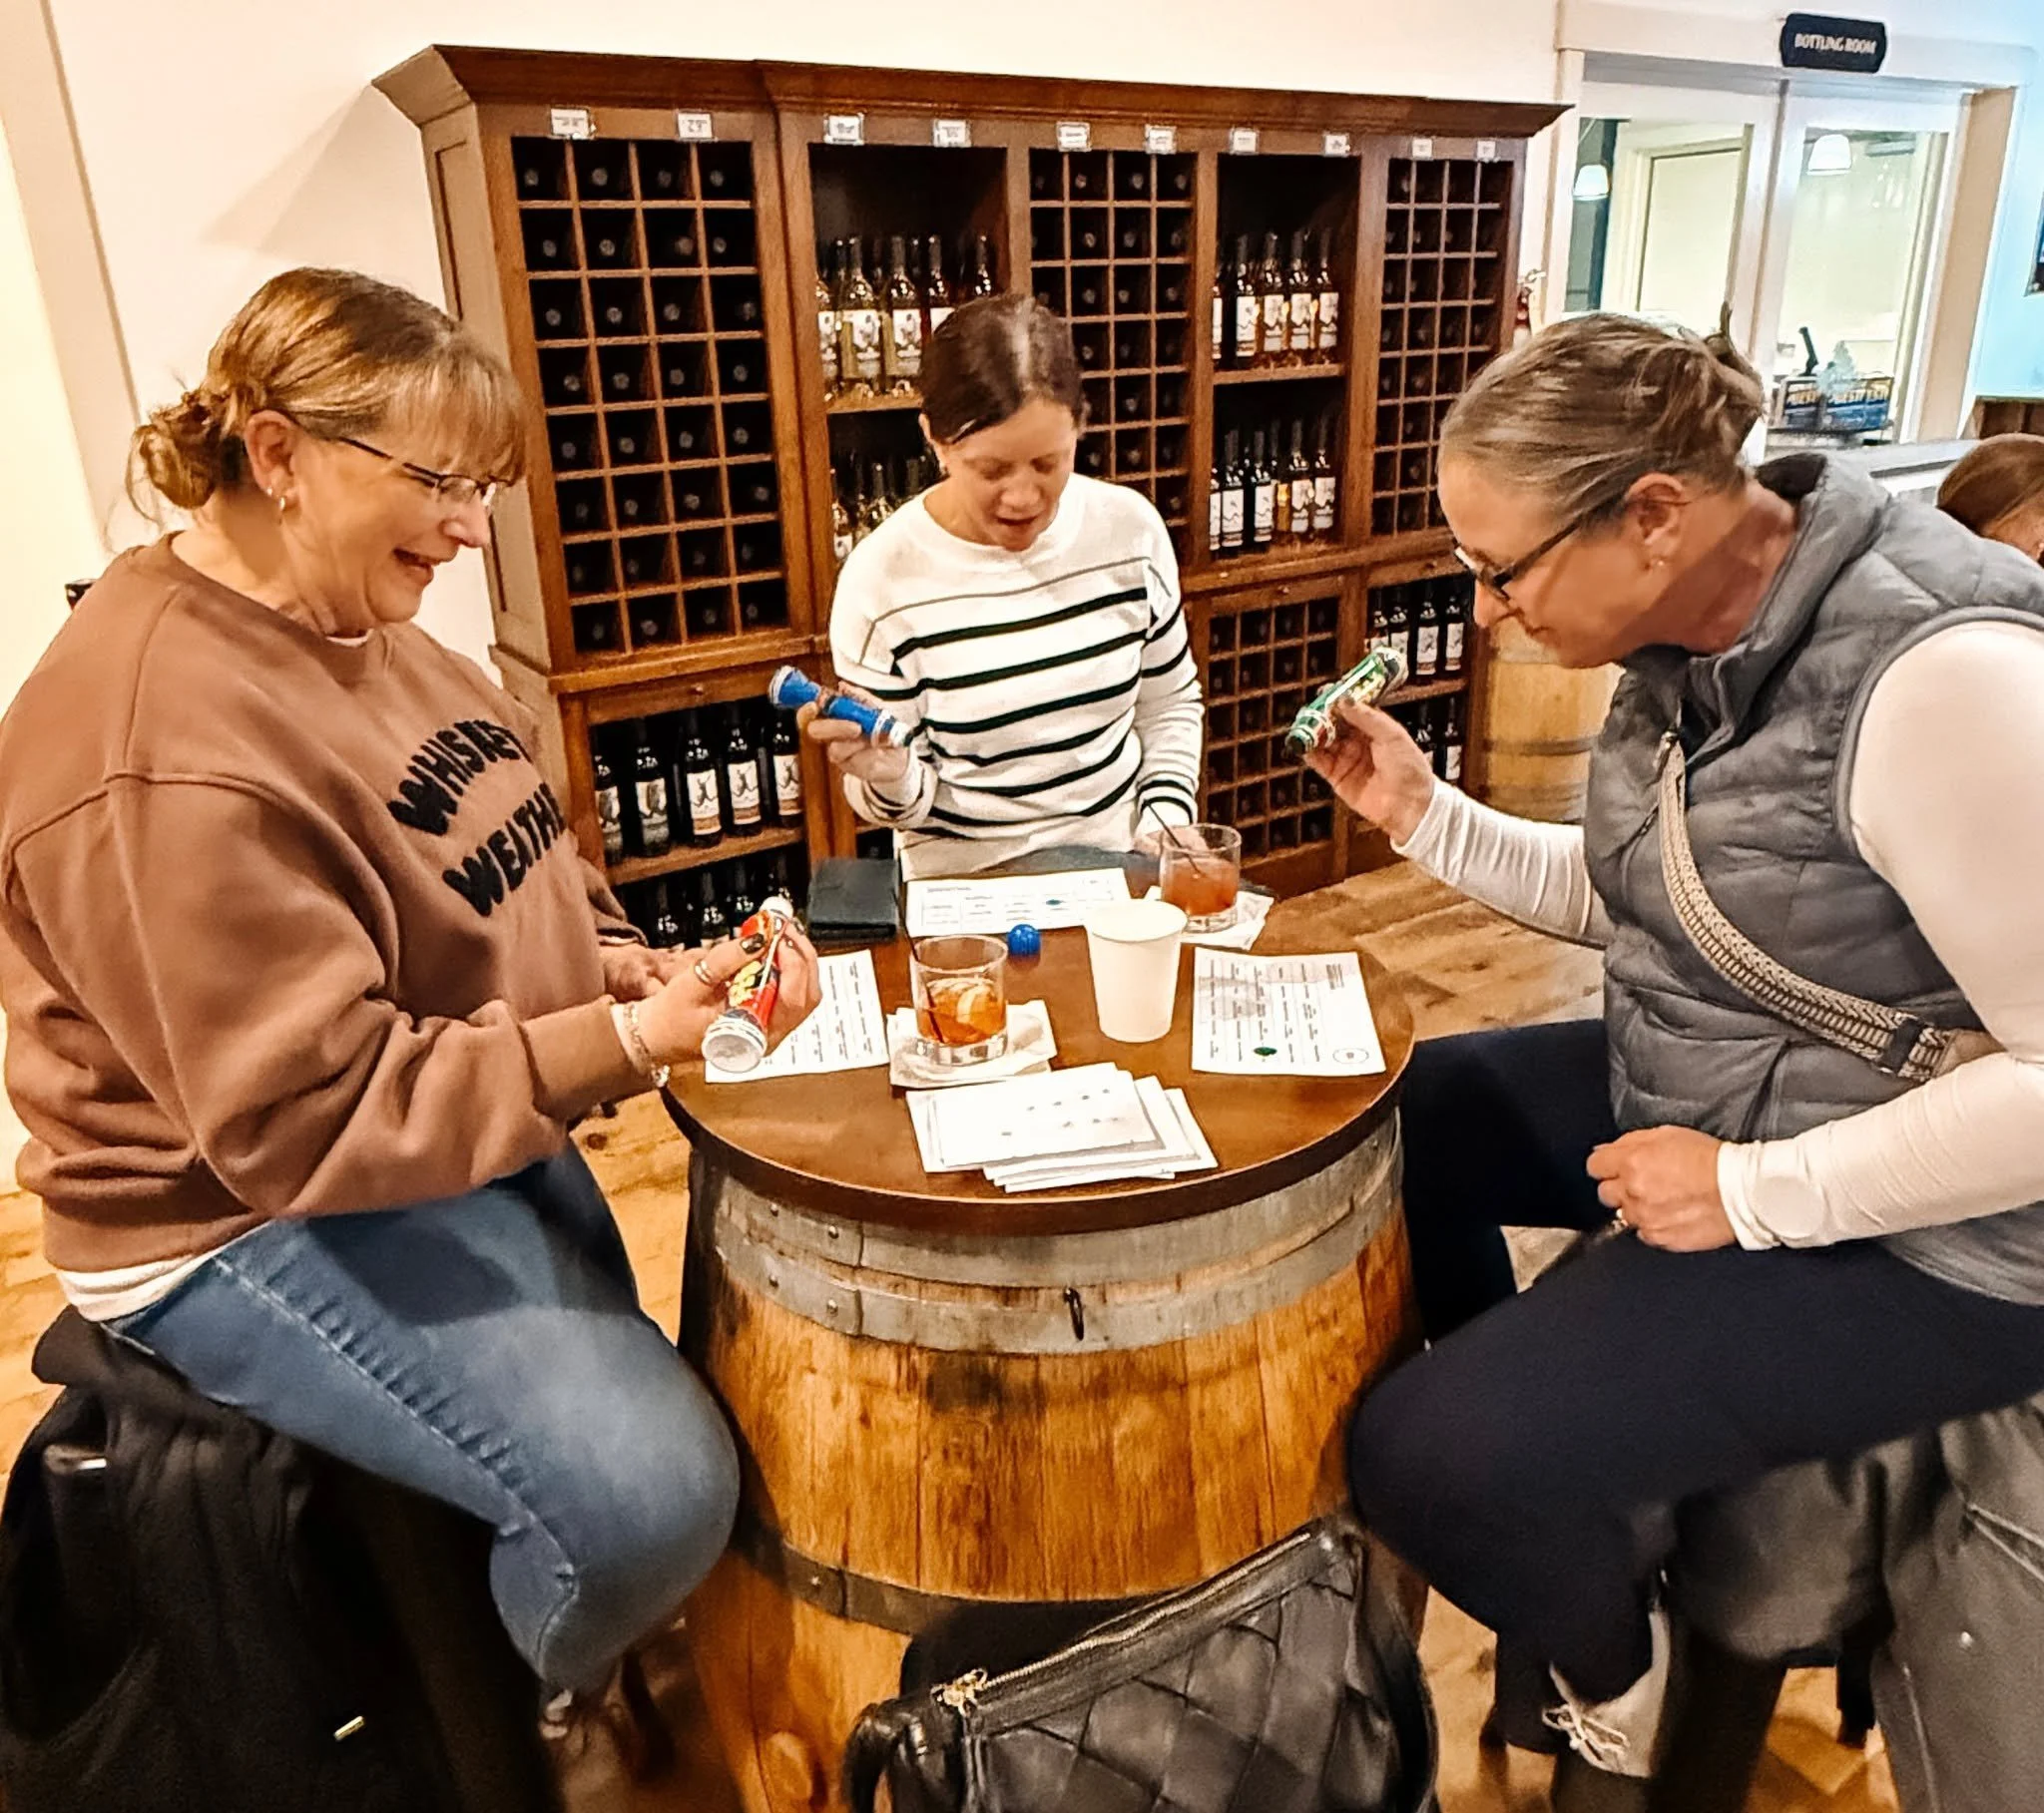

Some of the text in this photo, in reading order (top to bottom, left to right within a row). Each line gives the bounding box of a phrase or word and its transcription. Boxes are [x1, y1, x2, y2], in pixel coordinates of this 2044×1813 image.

[1794, 34, 1877, 54] BOTTLING ROOM
[386, 718, 533, 836] WHISKE
